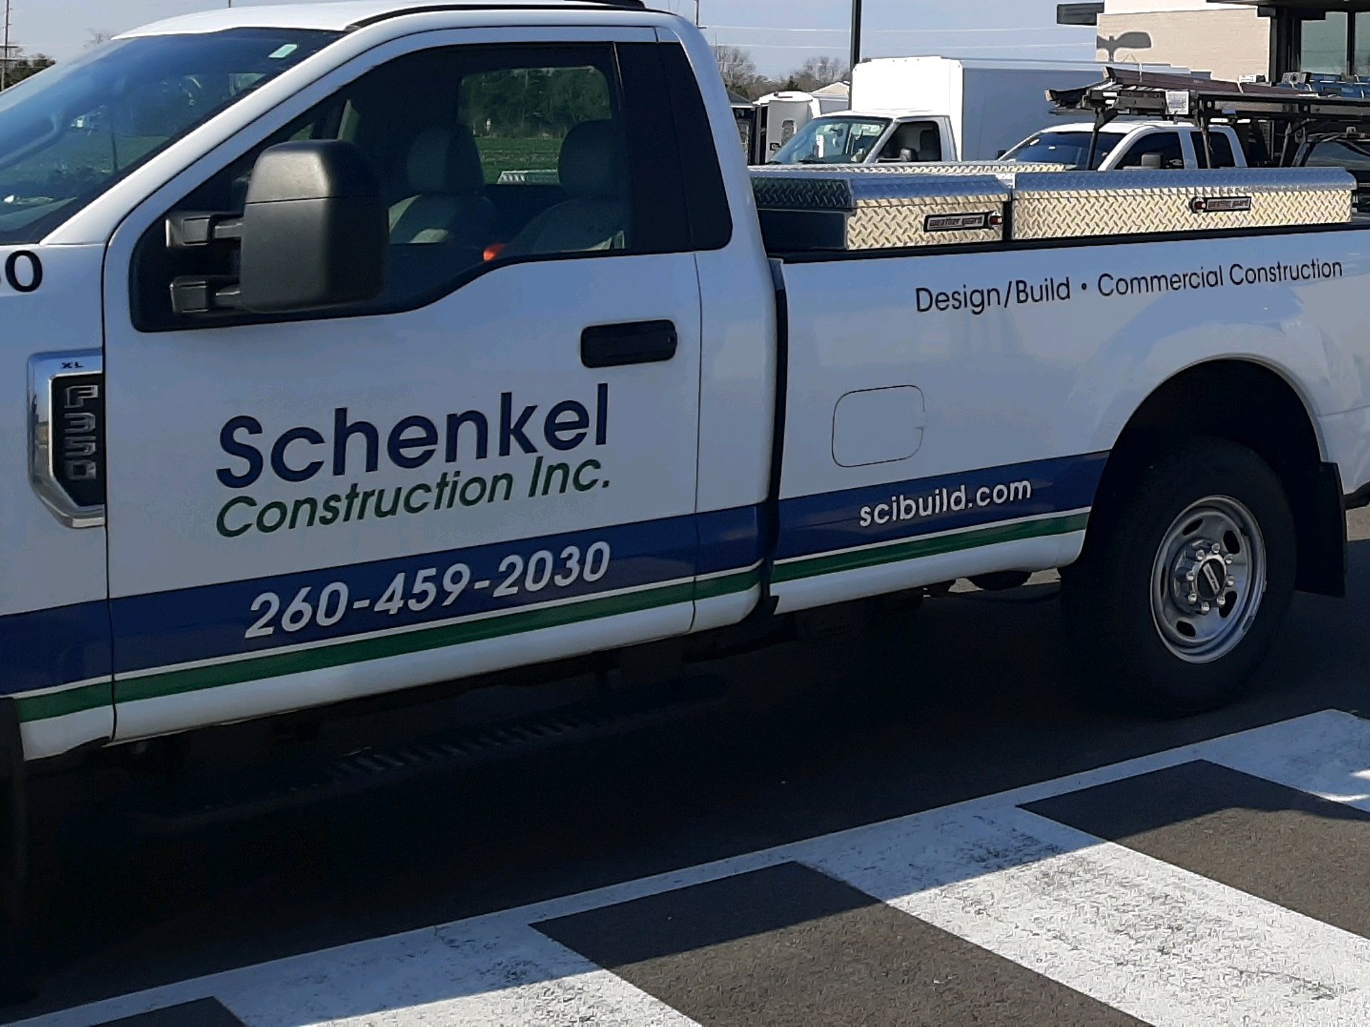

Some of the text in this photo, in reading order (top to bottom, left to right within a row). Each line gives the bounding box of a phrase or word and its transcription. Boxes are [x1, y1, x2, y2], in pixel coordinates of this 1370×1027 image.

[0, 249, 43, 293] 0
[915, 258, 1343, 315] Design/Build Commercial Construction
[61, 361, 84, 369] XL
[216, 383, 609, 489] Schenkel
[215, 455, 611, 538] Construction Inc.
[859, 480, 1032, 527] scibuild.com
[244, 541, 612, 640] 260-459-2030
